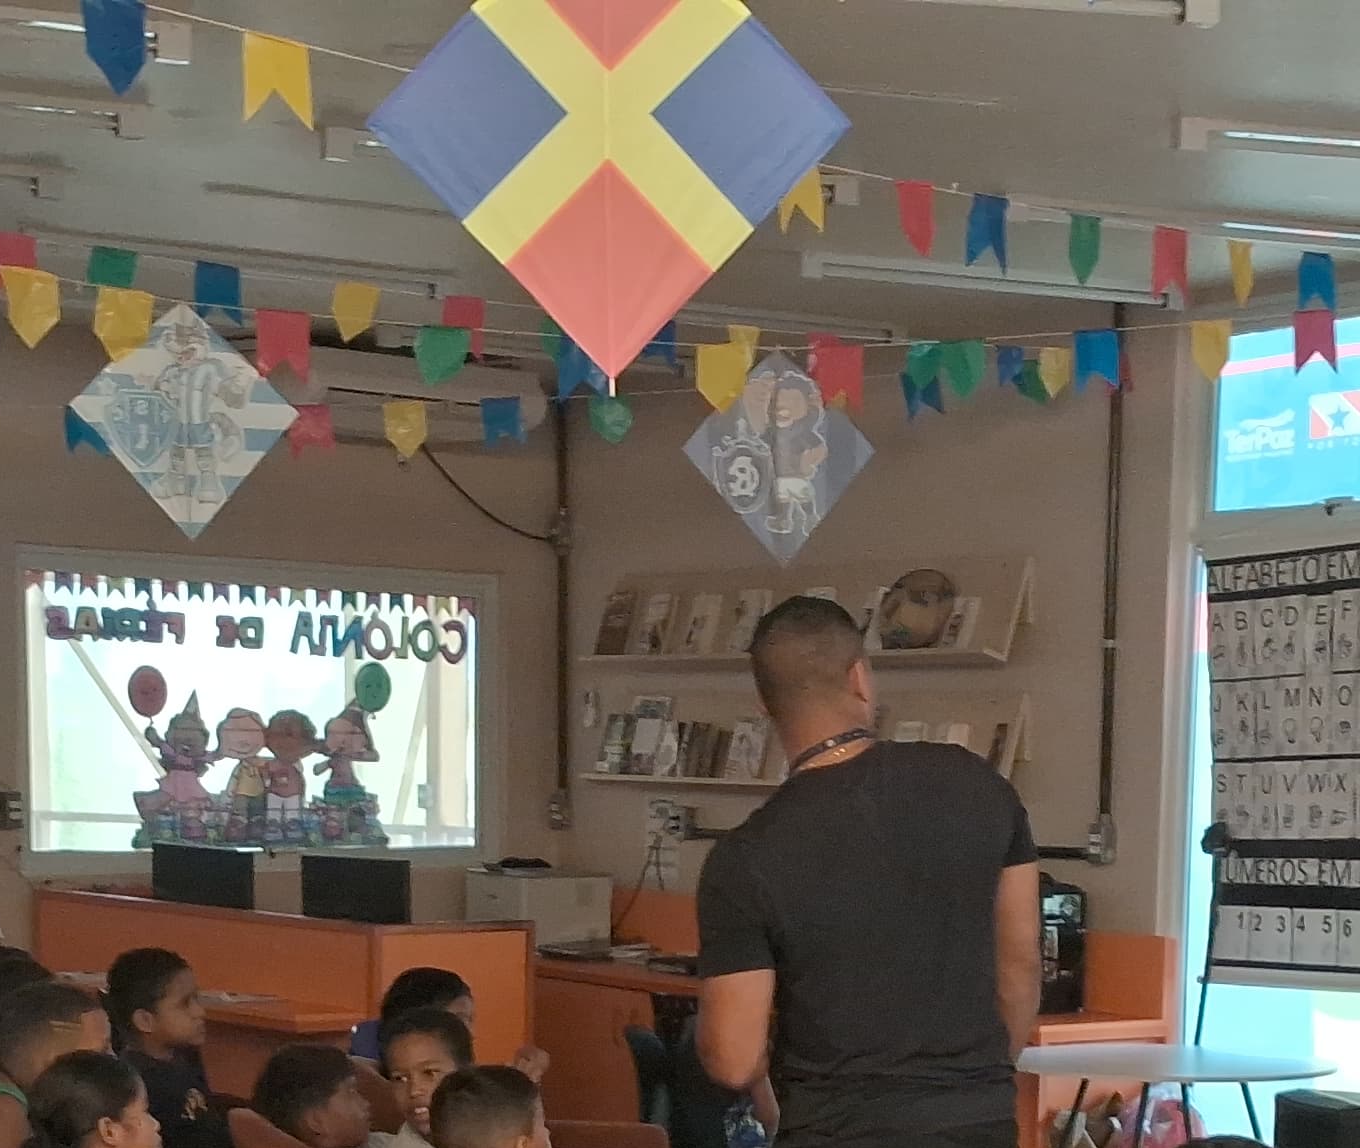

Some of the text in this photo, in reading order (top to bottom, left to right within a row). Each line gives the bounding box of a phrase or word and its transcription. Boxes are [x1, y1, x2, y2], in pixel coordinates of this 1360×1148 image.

[1207, 555, 1321, 593] ALFABETO
[1212, 615, 1224, 632] A
[1234, 611, 1249, 631] B
[1260, 608, 1274, 628] C
[1283, 605, 1299, 626] D
[1314, 605, 1328, 625] E
[1341, 600, 1352, 620] F
[1236, 693, 1248, 713] K
[1262, 690, 1271, 709] L
[1285, 687, 1300, 707] M
[1309, 687, 1323, 707] N
[1338, 685, 1352, 706] O
[1216, 774, 1227, 793] S
[1236, 774, 1247, 793] T
[1261, 774, 1272, 794] U
[1281, 773, 1297, 793] V
[1307, 773, 1326, 793] W
[1334, 773, 1347, 792] X
[1317, 860, 1352, 887] EM
[1252, 914, 1262, 931] 2
[1276, 915, 1286, 933] 3
[1296, 915, 1306, 932] 4
[1321, 915, 1333, 933] 5
[1342, 919, 1352, 937] 6
